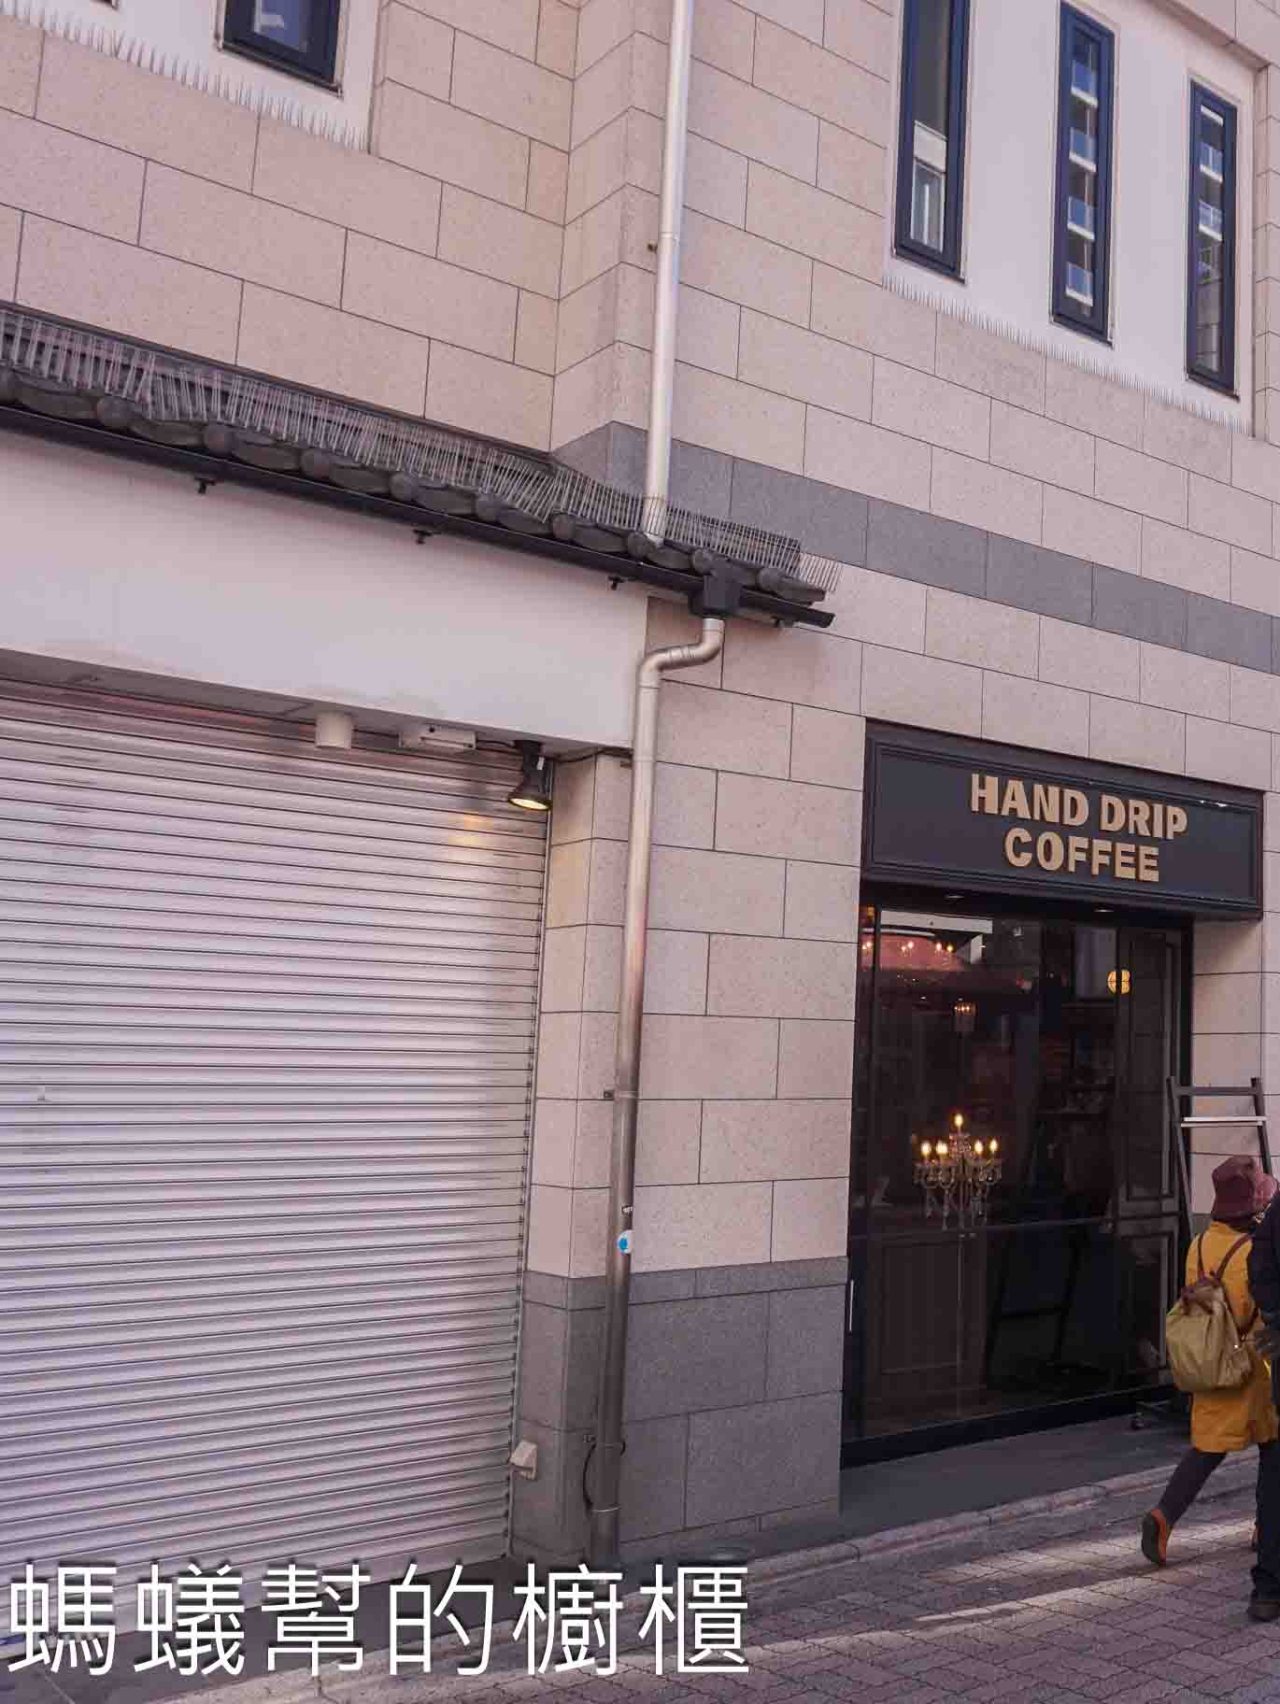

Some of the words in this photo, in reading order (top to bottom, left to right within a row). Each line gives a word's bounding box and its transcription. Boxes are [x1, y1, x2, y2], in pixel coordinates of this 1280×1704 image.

[971, 773, 1090, 827] HAND
[1100, 795, 1188, 840] DRIP
[1004, 827, 1160, 882] COFFEE
